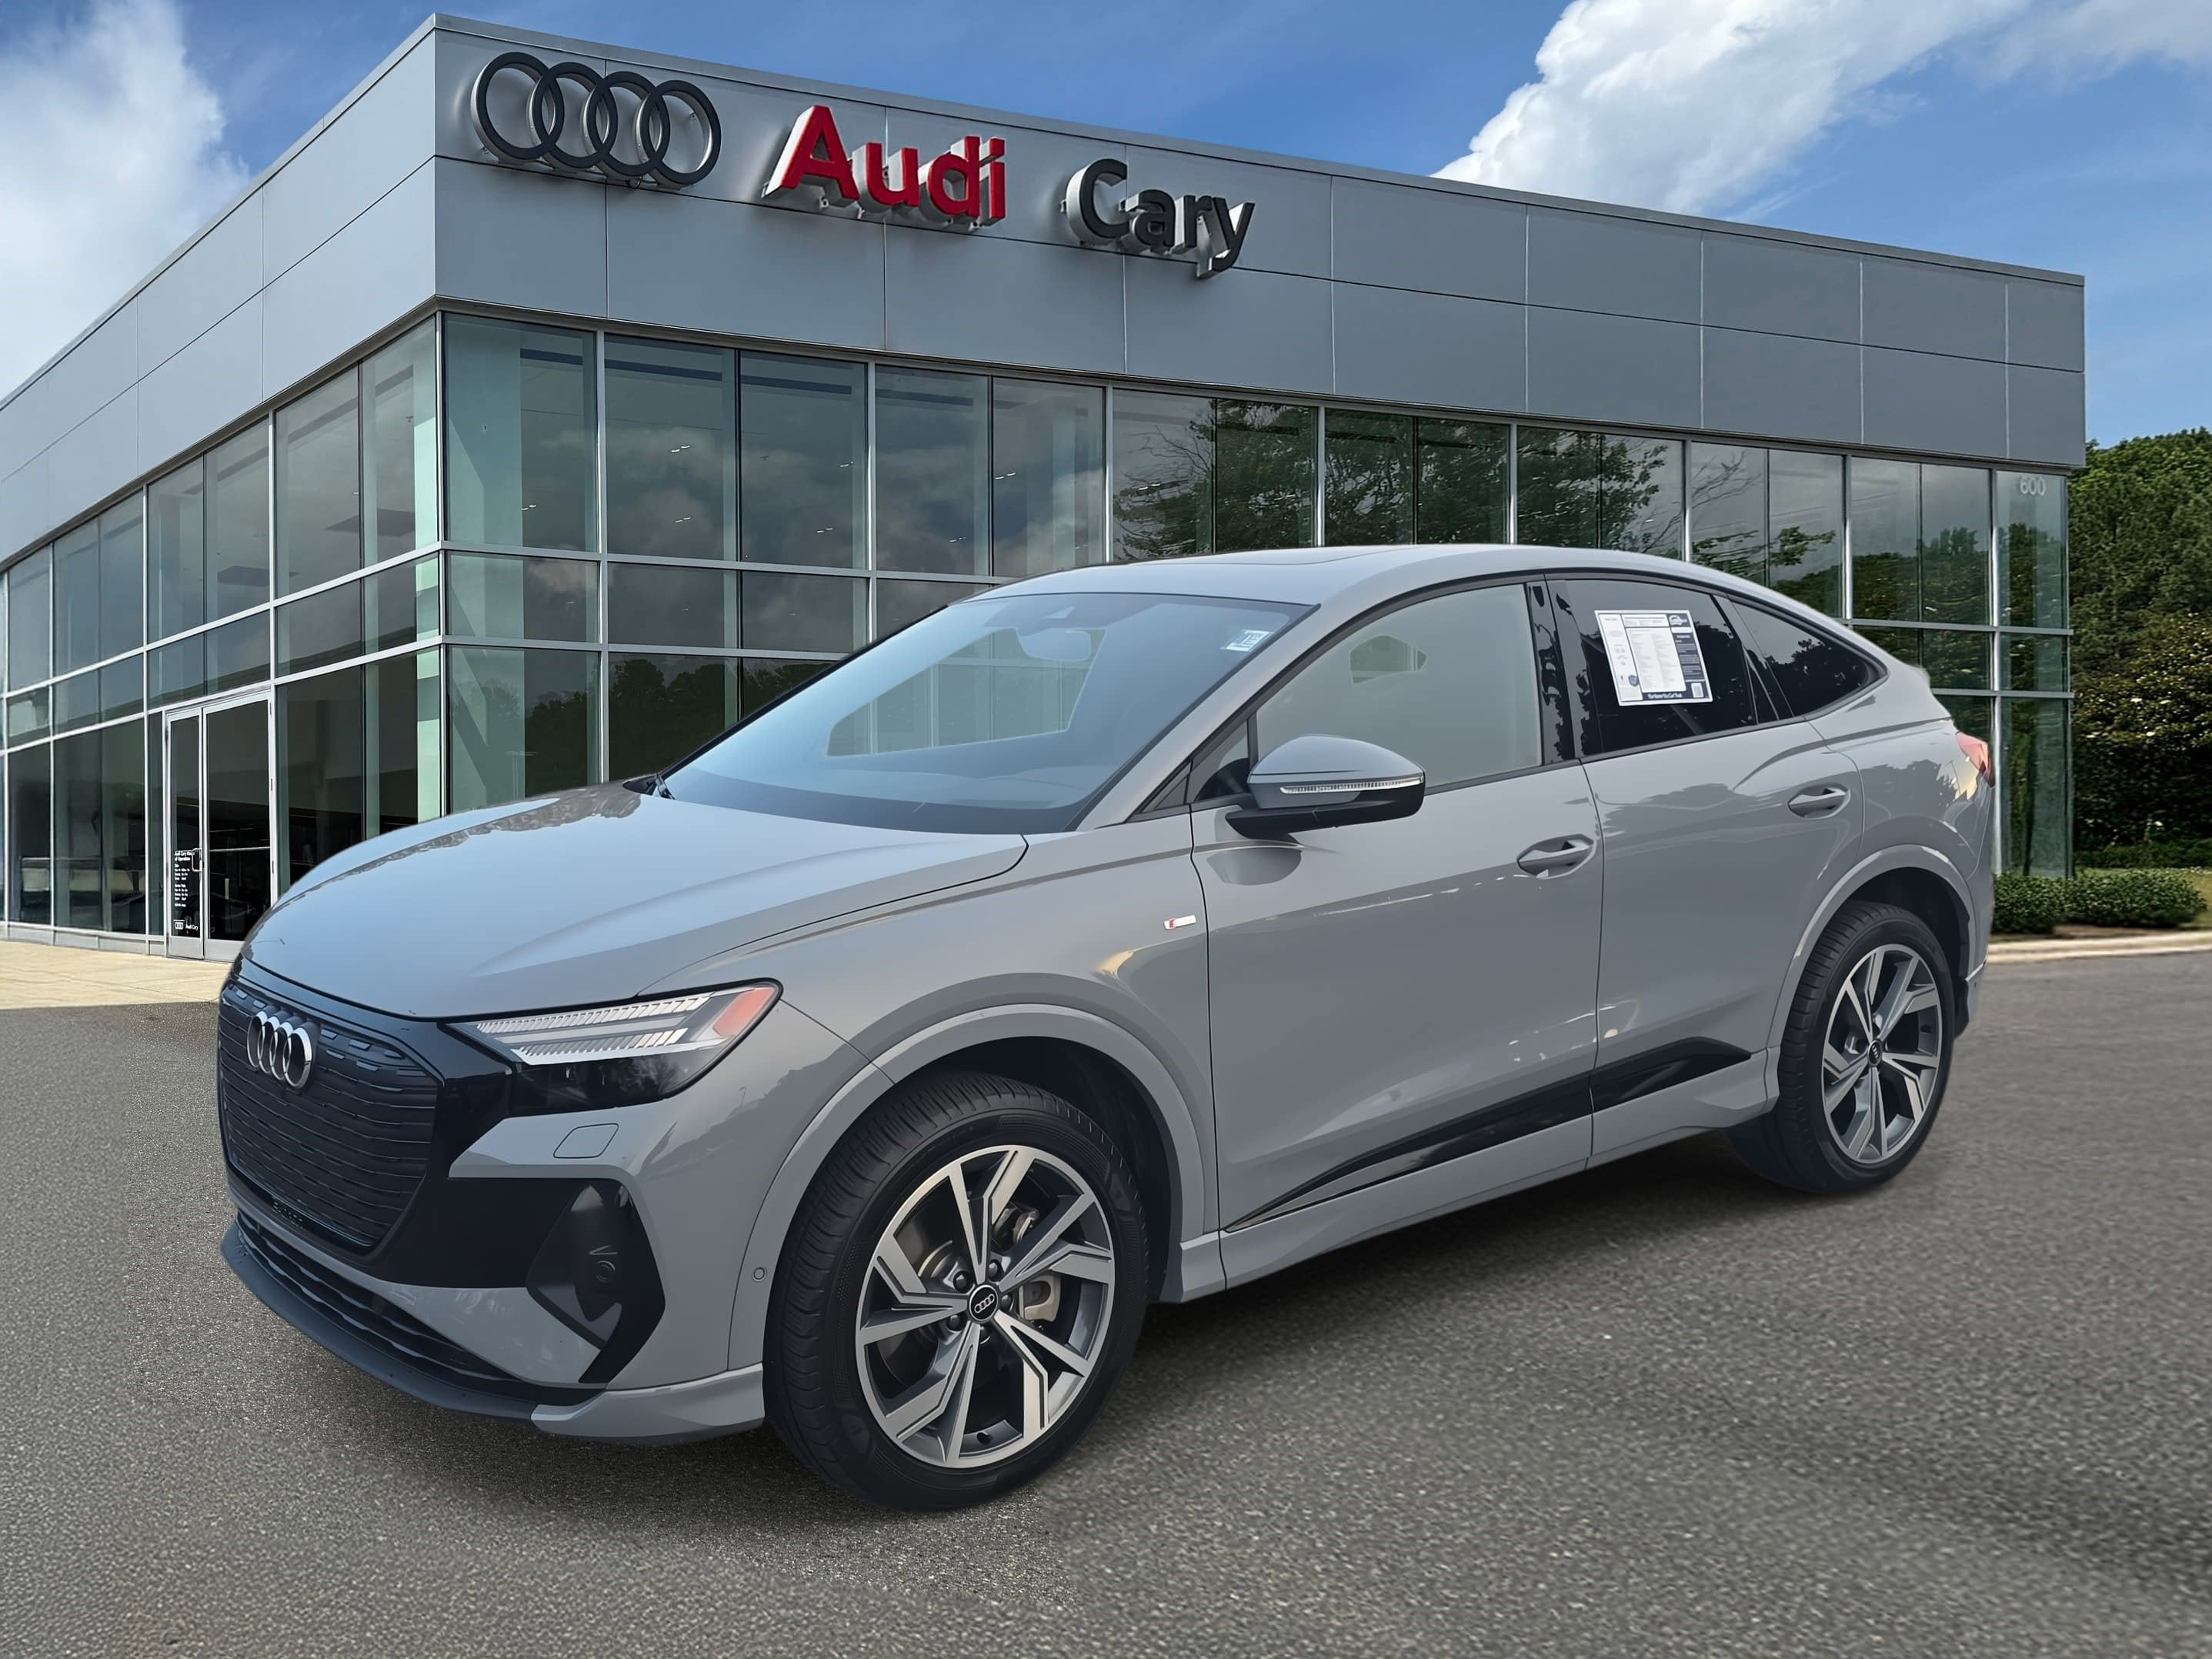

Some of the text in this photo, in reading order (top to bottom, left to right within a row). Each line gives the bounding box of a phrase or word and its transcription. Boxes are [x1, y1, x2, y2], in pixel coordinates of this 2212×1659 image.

[766, 105, 1256, 272] Audi Cary
[2020, 476, 2046, 496] 600
